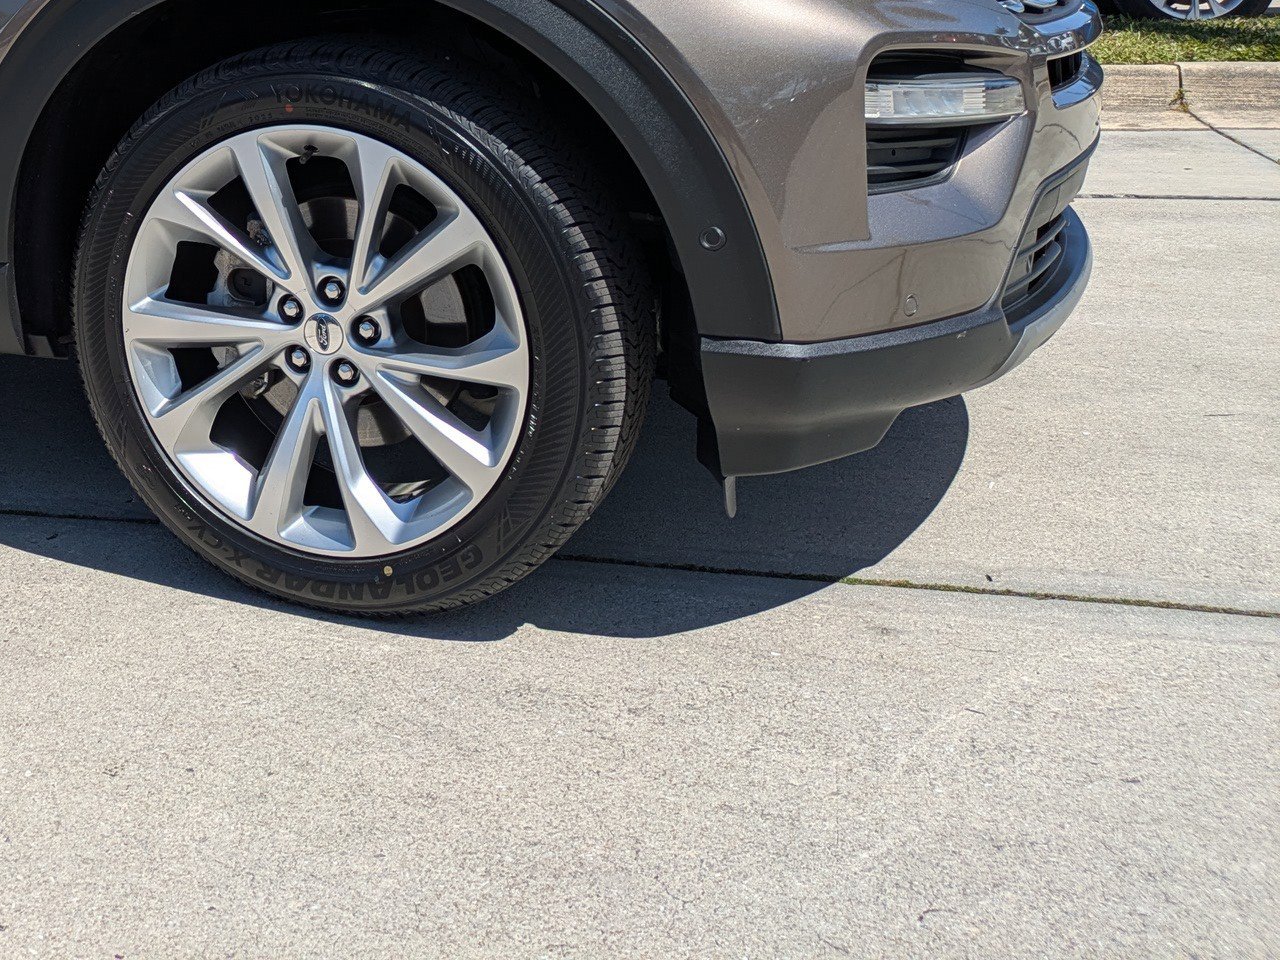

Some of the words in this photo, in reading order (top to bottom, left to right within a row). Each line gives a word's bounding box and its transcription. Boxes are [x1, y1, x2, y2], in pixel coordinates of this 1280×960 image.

[269, 83, 411, 134] YOKOHAMA
[319, 324, 328, 346] Ford
[256, 543, 483, 601] GEOLANDAR
